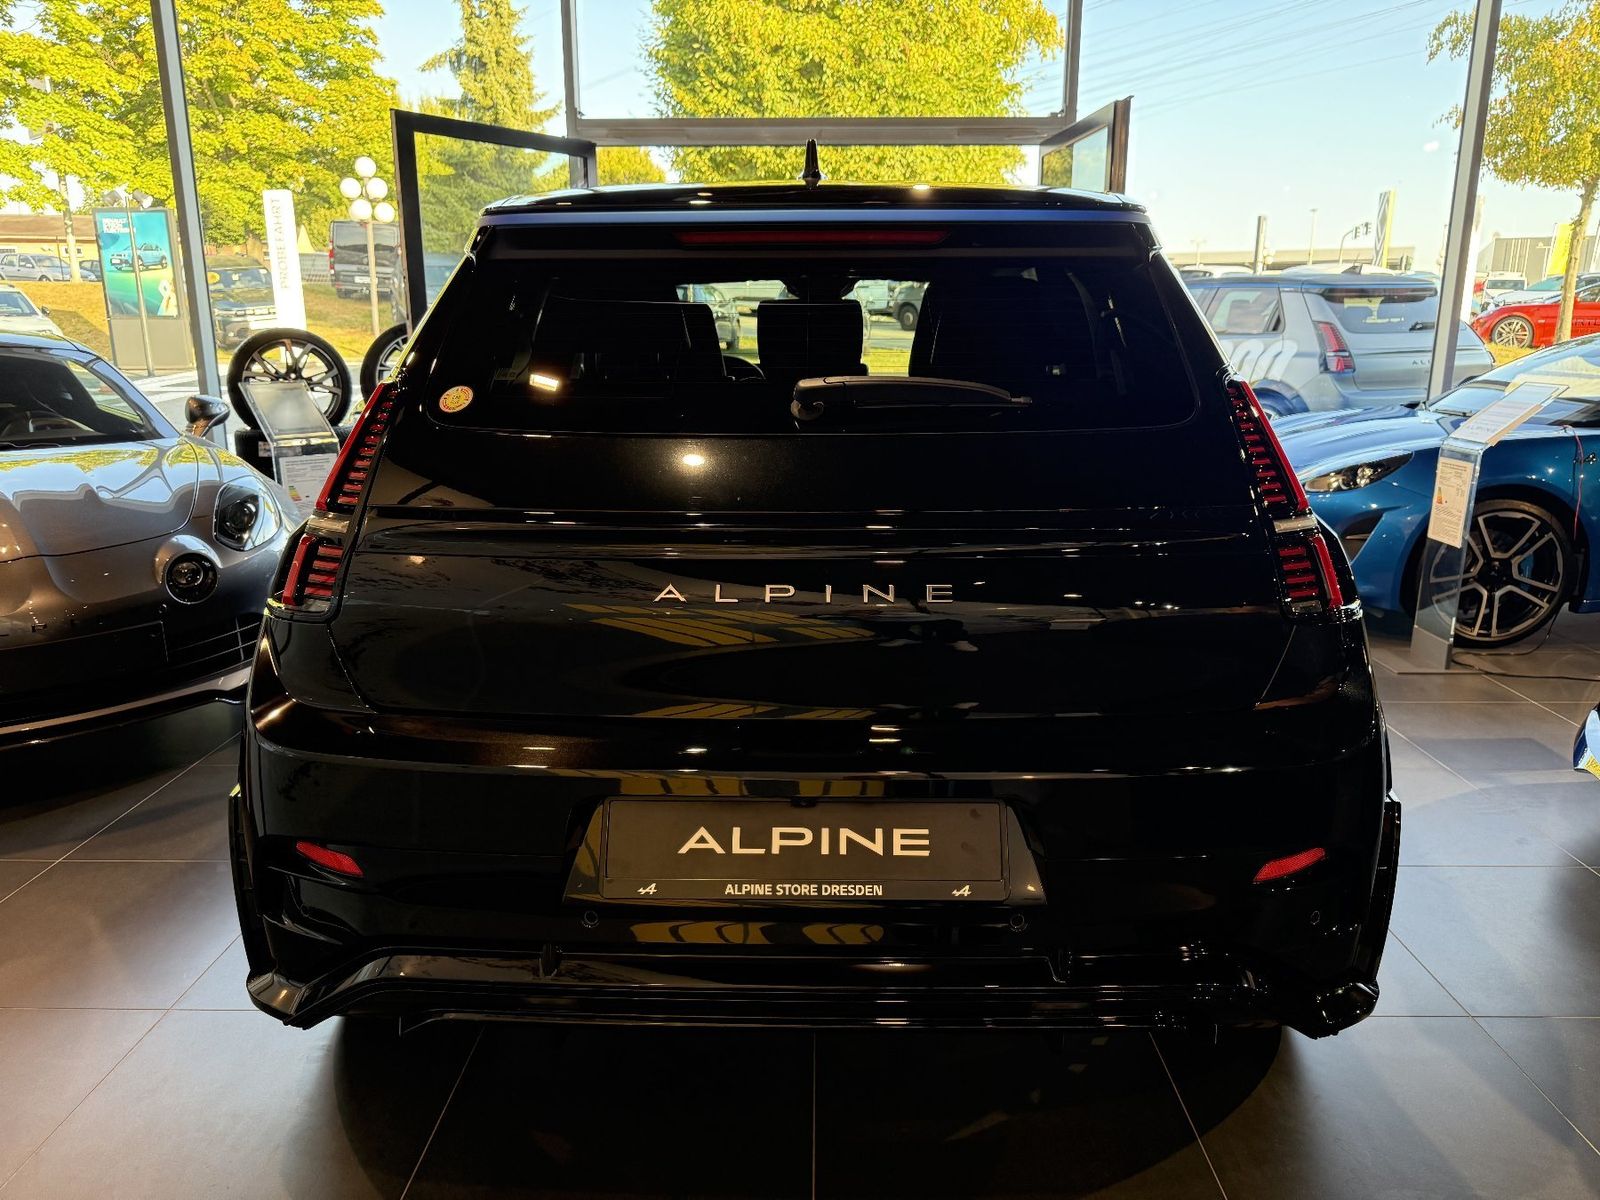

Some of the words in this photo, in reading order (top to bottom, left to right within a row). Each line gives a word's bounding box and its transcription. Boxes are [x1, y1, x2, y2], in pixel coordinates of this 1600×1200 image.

[652, 583, 953, 603] ALPINE
[677, 826, 931, 857] ALPINE
[724, 883, 772, 895] ALPINE
[776, 883, 818, 896] STORE
[821, 884, 883, 896] DRESDEN
